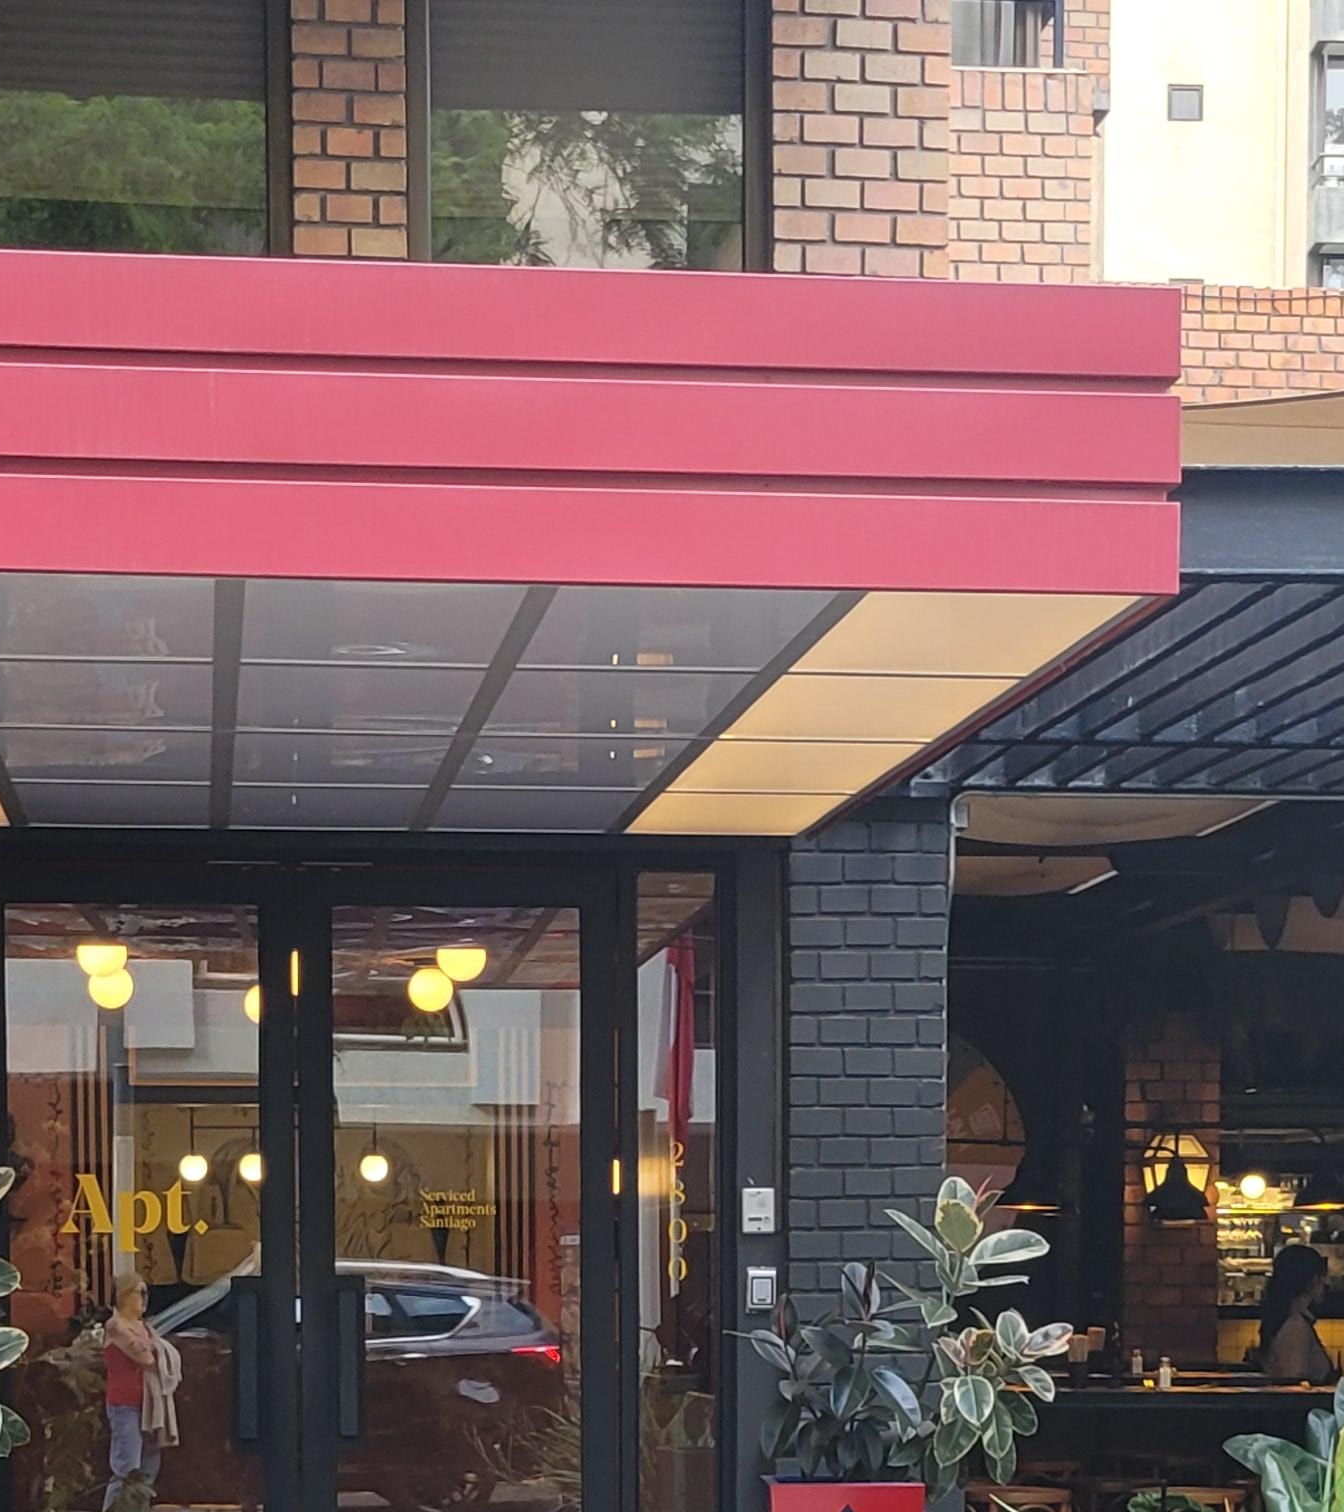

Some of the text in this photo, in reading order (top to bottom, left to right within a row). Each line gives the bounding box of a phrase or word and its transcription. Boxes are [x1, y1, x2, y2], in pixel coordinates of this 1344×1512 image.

[420, 1188, 475, 1201] Serviced
[60, 1174, 209, 1252] Apt.
[420, 1201, 496, 1217] Apartments
[420, 1215, 476, 1232] Santiago
